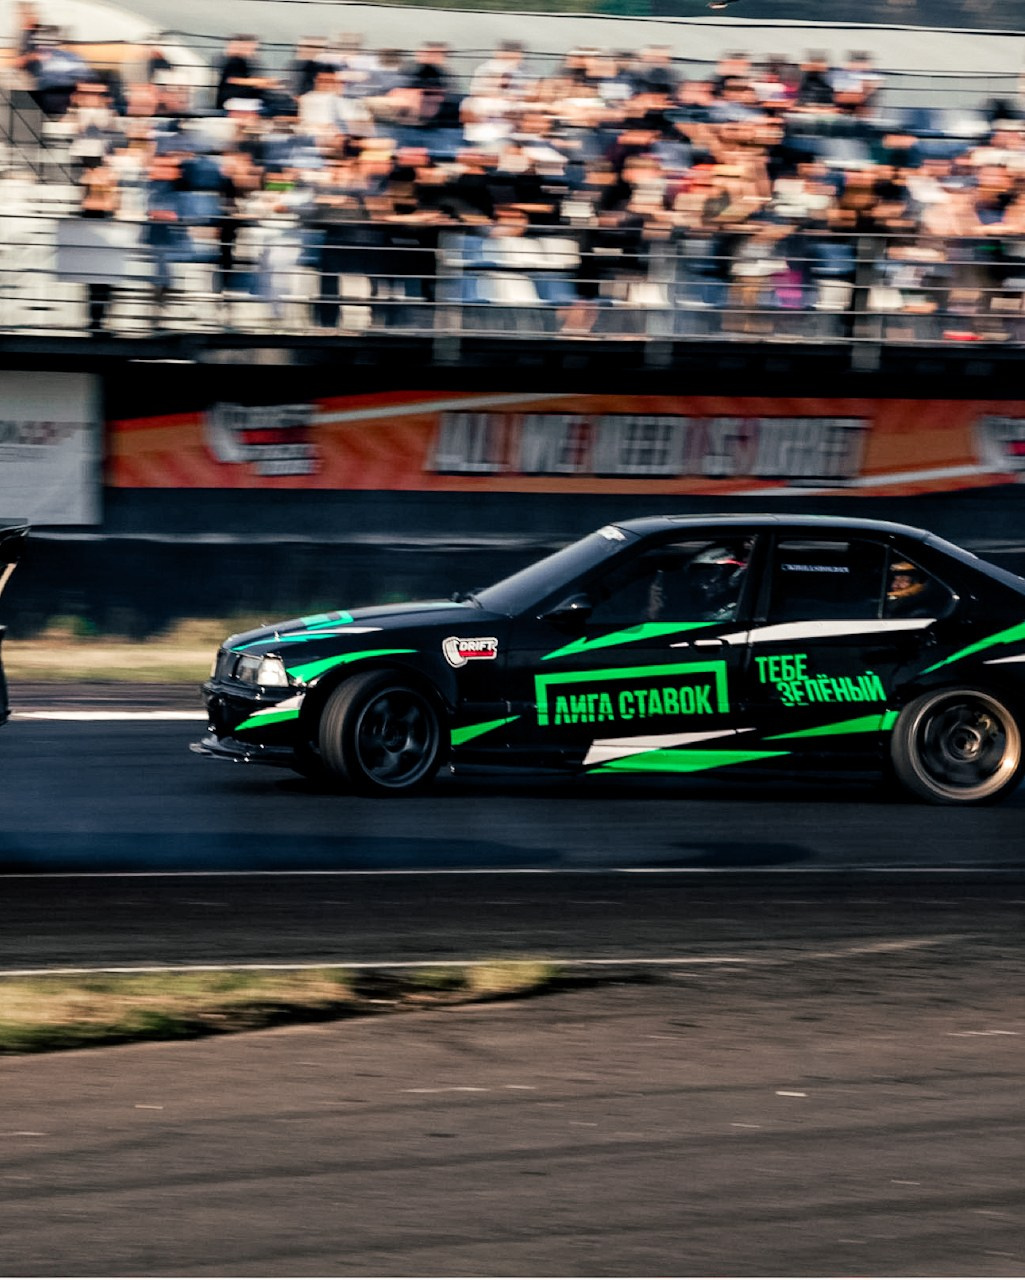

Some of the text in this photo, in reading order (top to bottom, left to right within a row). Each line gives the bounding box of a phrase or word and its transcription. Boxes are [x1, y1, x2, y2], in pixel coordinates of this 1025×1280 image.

[459, 640, 495, 652] DRIFT
[755, 653, 809, 684] ТЕБЕ
[554, 684, 714, 725] ЛИГА СТАВОК
[777, 670, 887, 707] ЗЕЛЁНЫЙ
